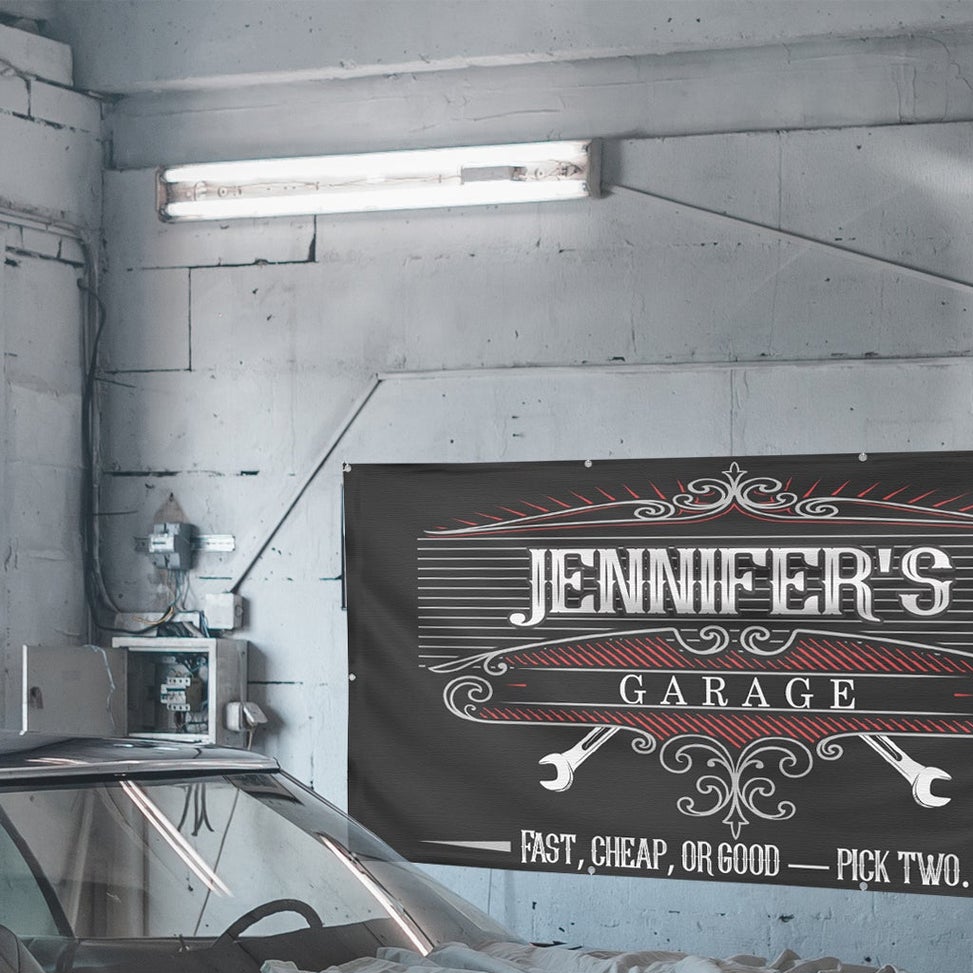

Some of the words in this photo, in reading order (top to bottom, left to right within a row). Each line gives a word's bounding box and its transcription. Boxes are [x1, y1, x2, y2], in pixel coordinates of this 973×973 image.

[509, 546, 953, 627] JENNIFER'S
[619, 674, 856, 709] GARAGE
[521, 829, 584, 870] FAST,
[591, 835, 675, 876] CHEAP,
[681, 840, 714, 876] OR
[717, 841, 780, 877] GOOD
[836, 847, 891, 883] PICK
[897, 850, 970, 888] TWO.
